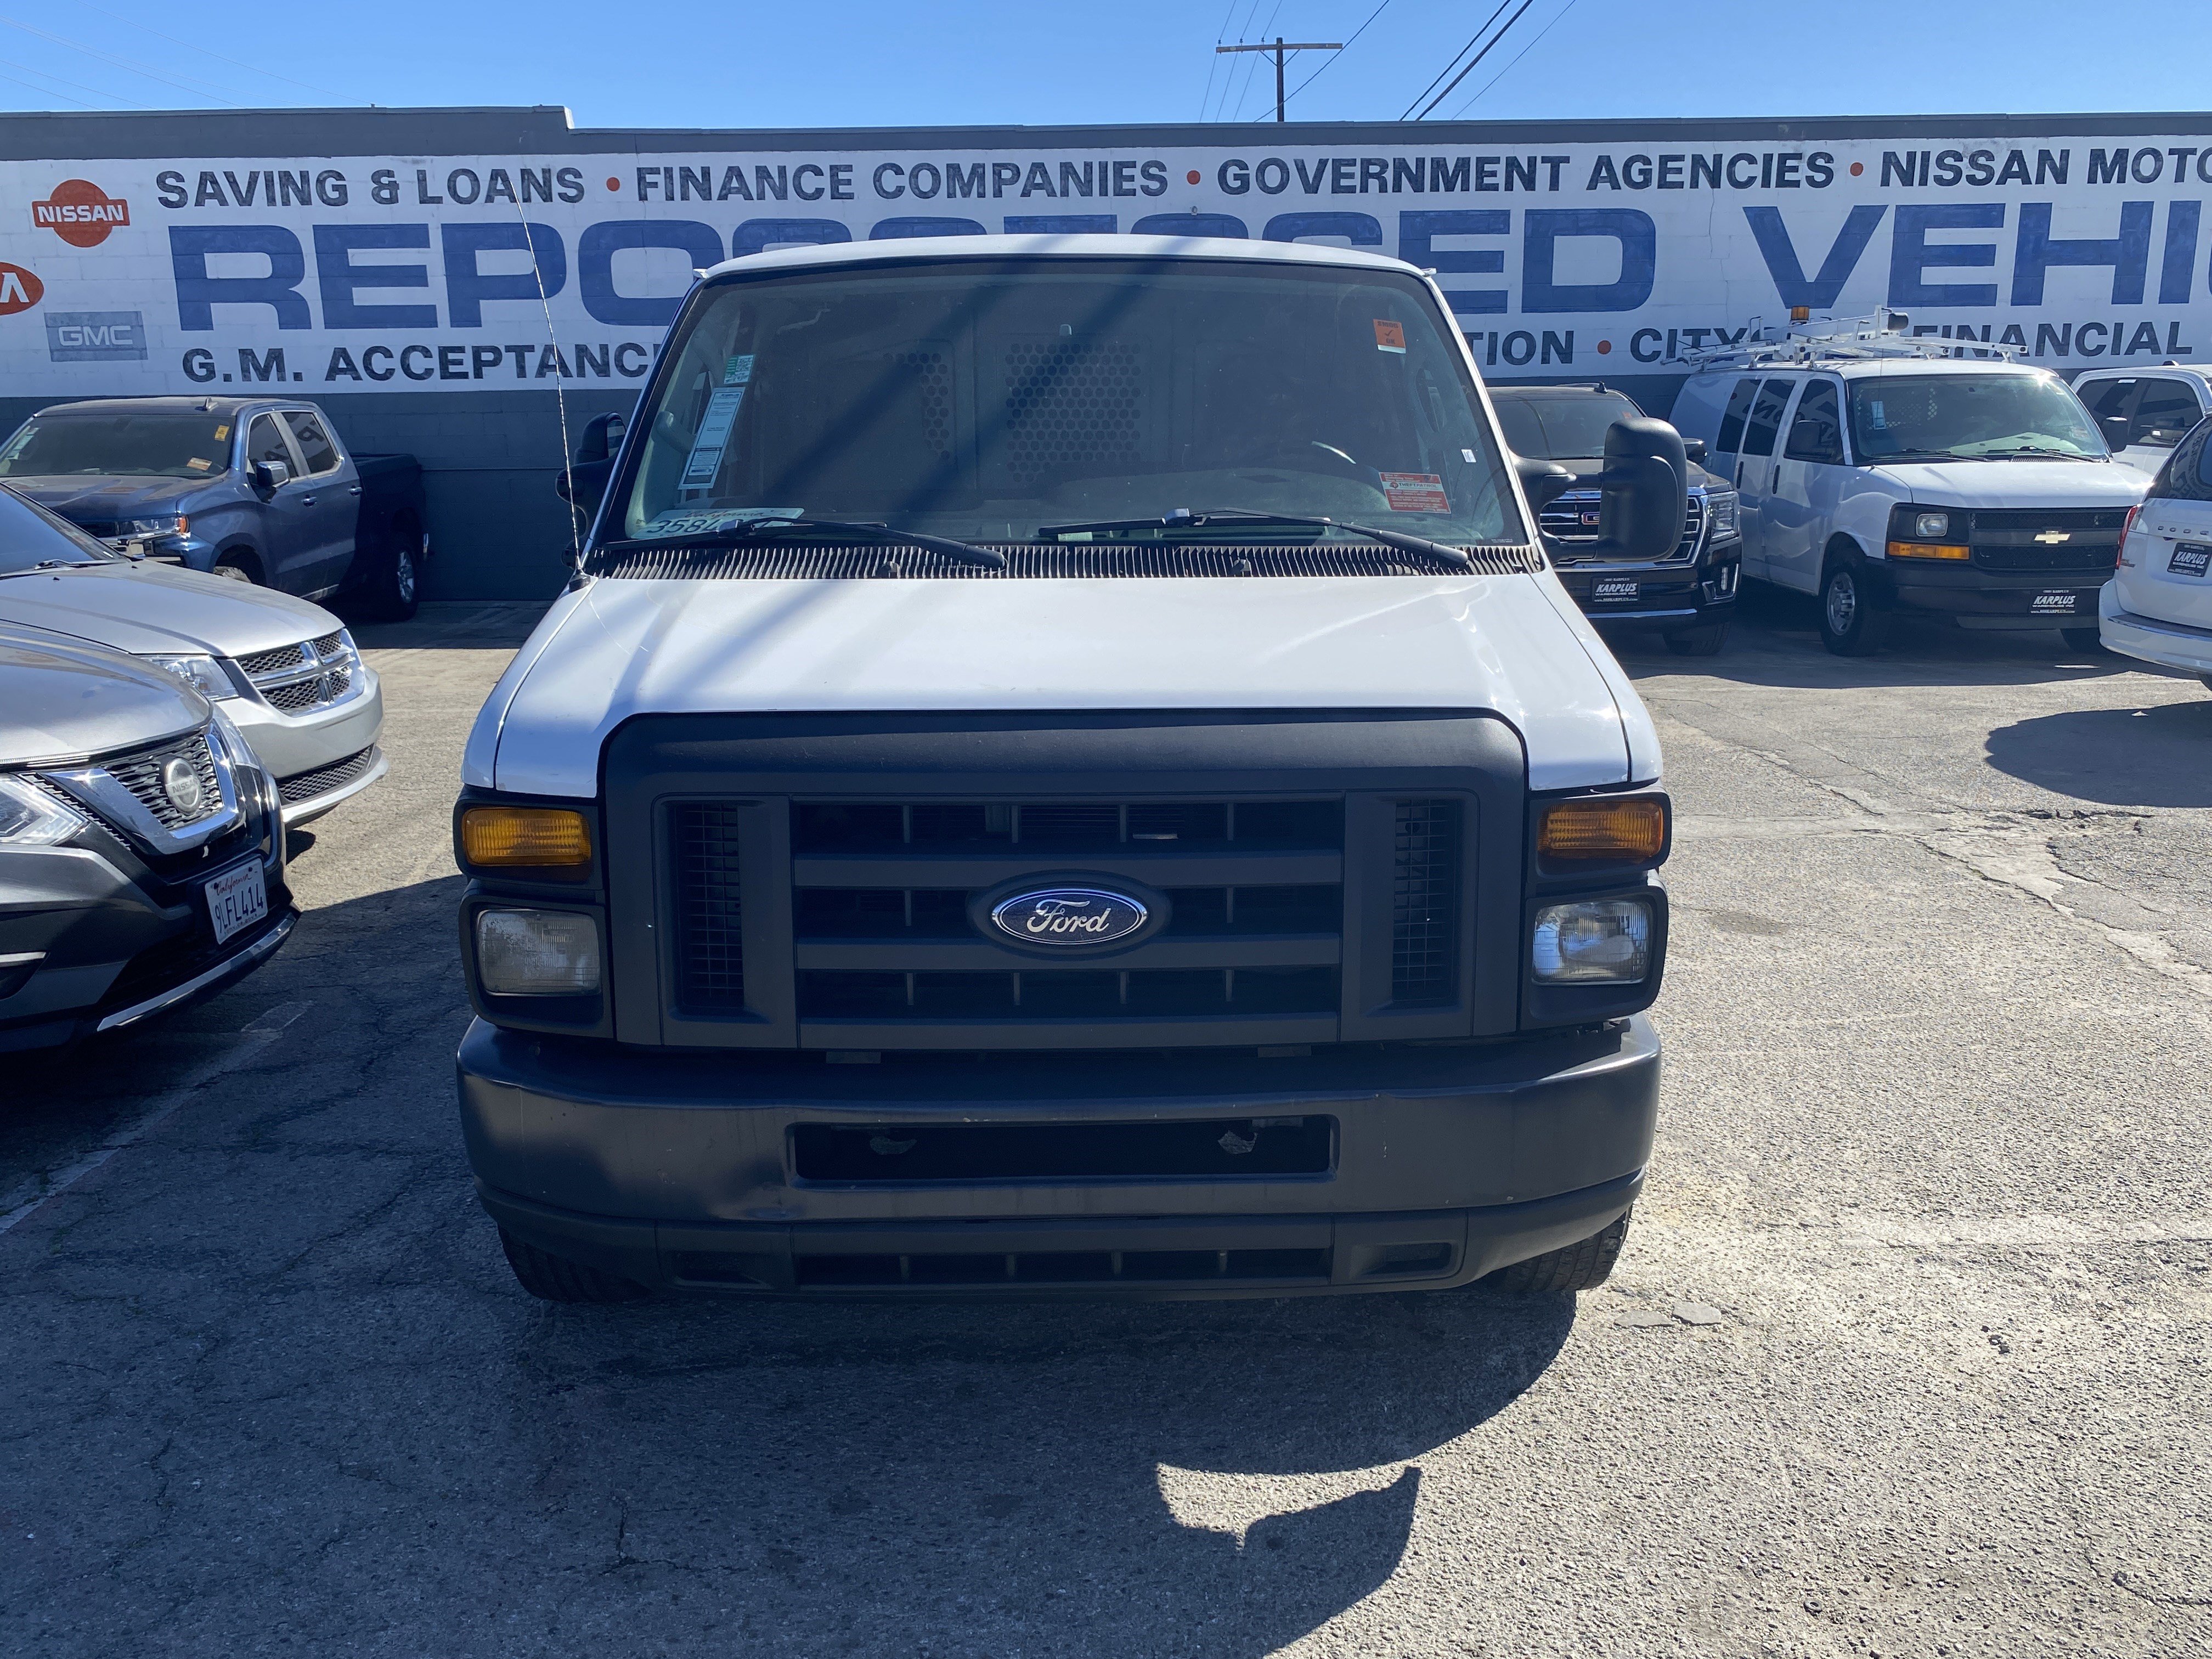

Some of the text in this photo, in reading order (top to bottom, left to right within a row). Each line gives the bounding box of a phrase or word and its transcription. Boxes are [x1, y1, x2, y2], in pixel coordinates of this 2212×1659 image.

[156, 170, 349, 208] SAVING
[371, 169, 400, 205] &
[417, 167, 585, 208] LOANS
[637, 163, 854, 203] FINANCE
[873, 160, 1168, 200] COMPANIES
[1217, 155, 1571, 195] GOVERNMENT
[1586, 151, 1834, 190] AGENCIES
[1880, 149, 2070, 187] NISSAN
[37, 204, 124, 223] NISSAN
[1742, 200, 2212, 309] VEHI
[58, 324, 134, 347] GMC
[183, 347, 303, 383] G.M.
[2174, 551, 2209, 565] KARPLUS
[1595, 583, 1638, 593] KARPLUS
[2033, 595, 2076, 605] KARPLUS
[217, 873, 252, 896] California
[215, 883, 263, 933] 9LFL414
[1026, 899, 1111, 933] Ford
